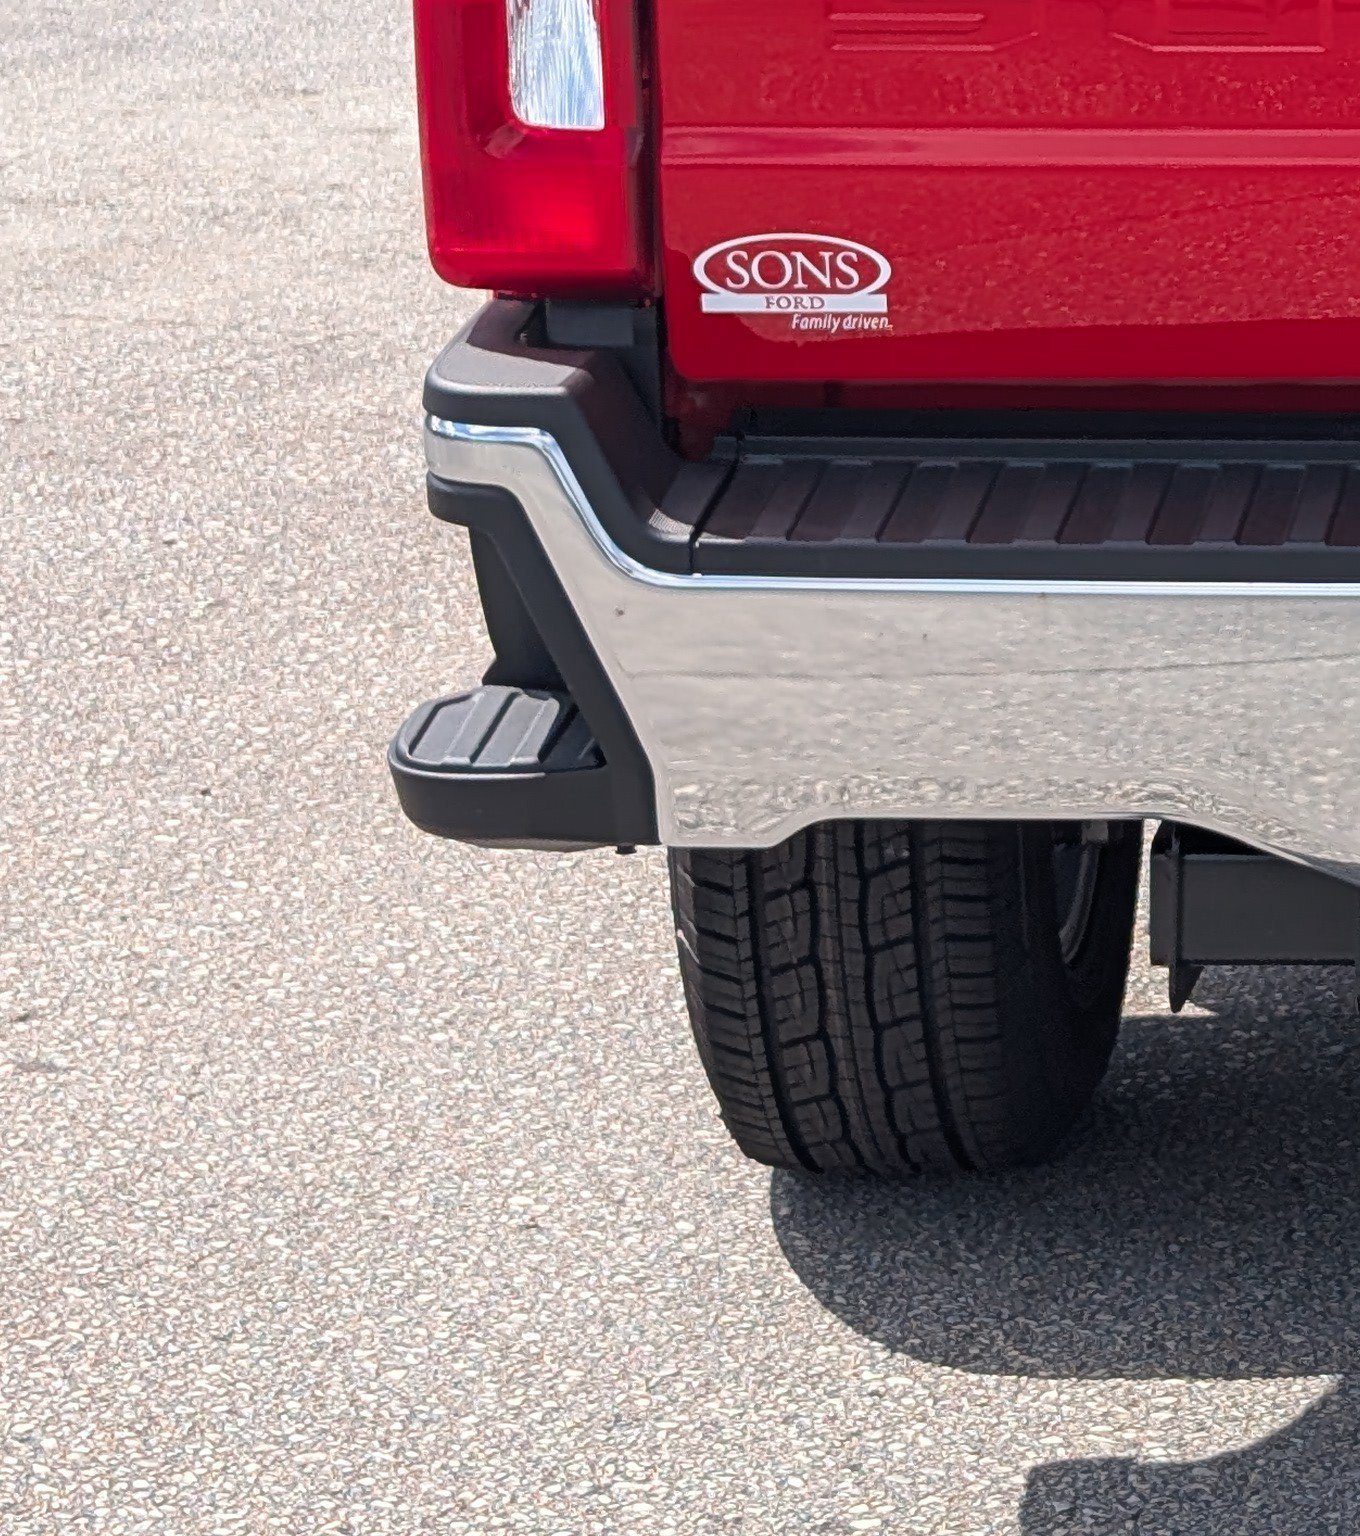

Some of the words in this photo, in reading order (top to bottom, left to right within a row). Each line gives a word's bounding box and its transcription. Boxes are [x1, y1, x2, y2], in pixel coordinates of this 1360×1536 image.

[725, 250, 860, 290] SONS
[764, 295, 826, 310] FORD
[791, 314, 841, 334] Family
